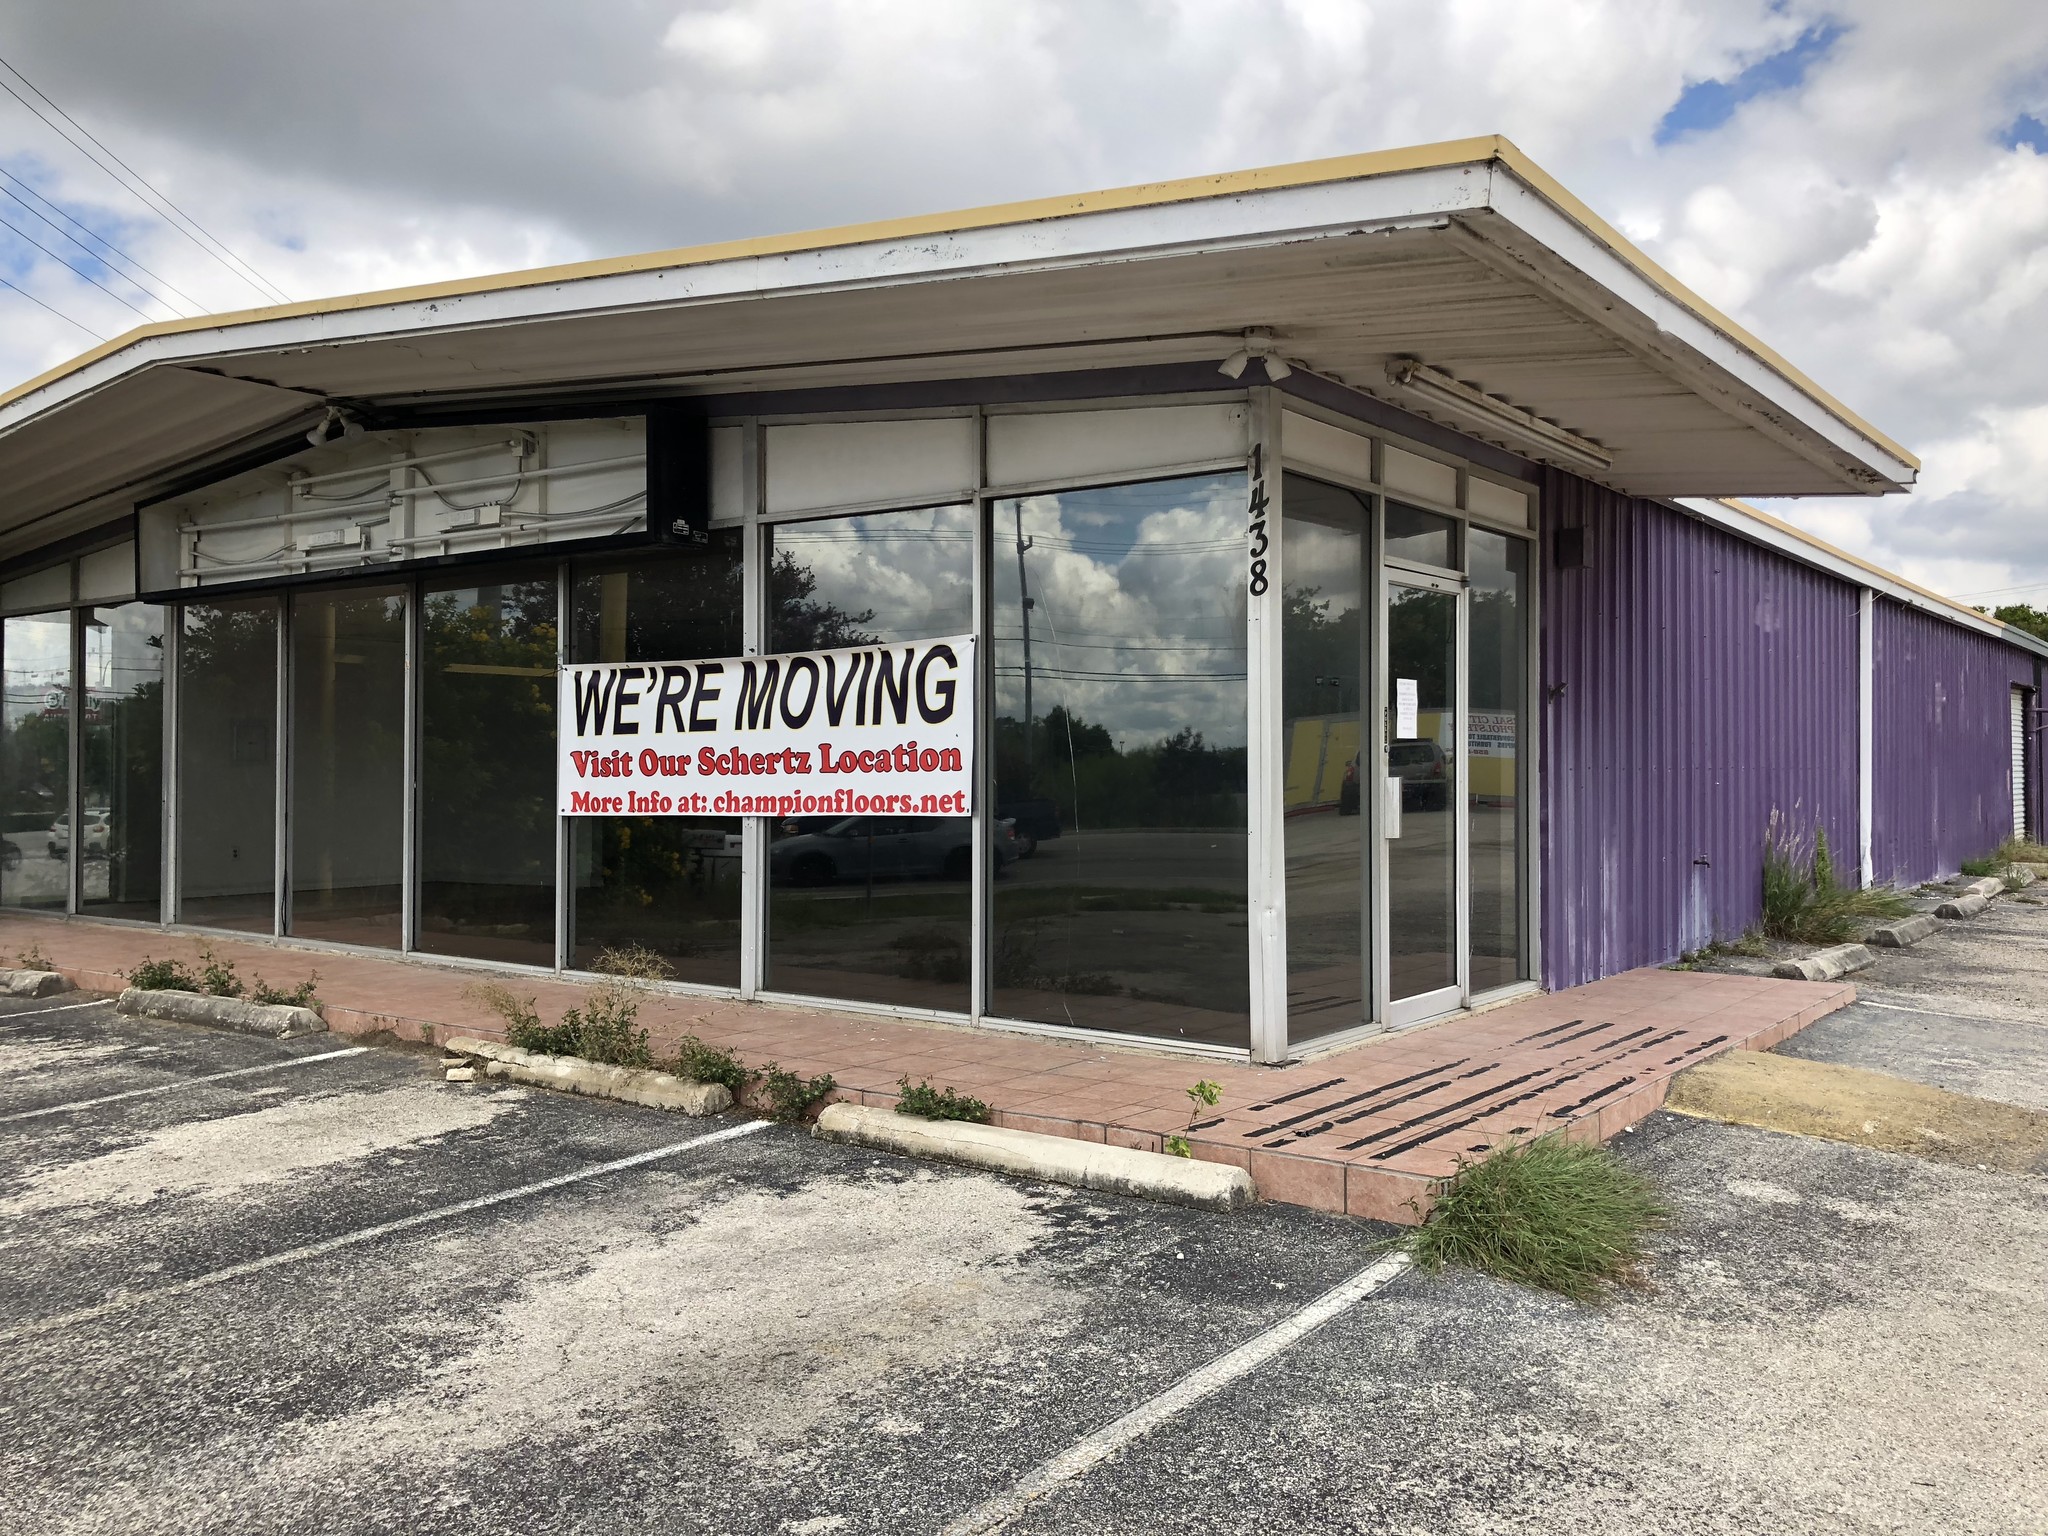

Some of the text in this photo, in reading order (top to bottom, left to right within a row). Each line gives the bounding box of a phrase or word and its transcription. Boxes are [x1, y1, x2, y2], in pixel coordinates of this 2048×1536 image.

[1248, 443, 1270, 597] 1438
[574, 644, 958, 737] WE'RE MOVING
[570, 741, 963, 778] Visit Our Schertz Location
[571, 788, 966, 817] More Info at: championfloors.net
